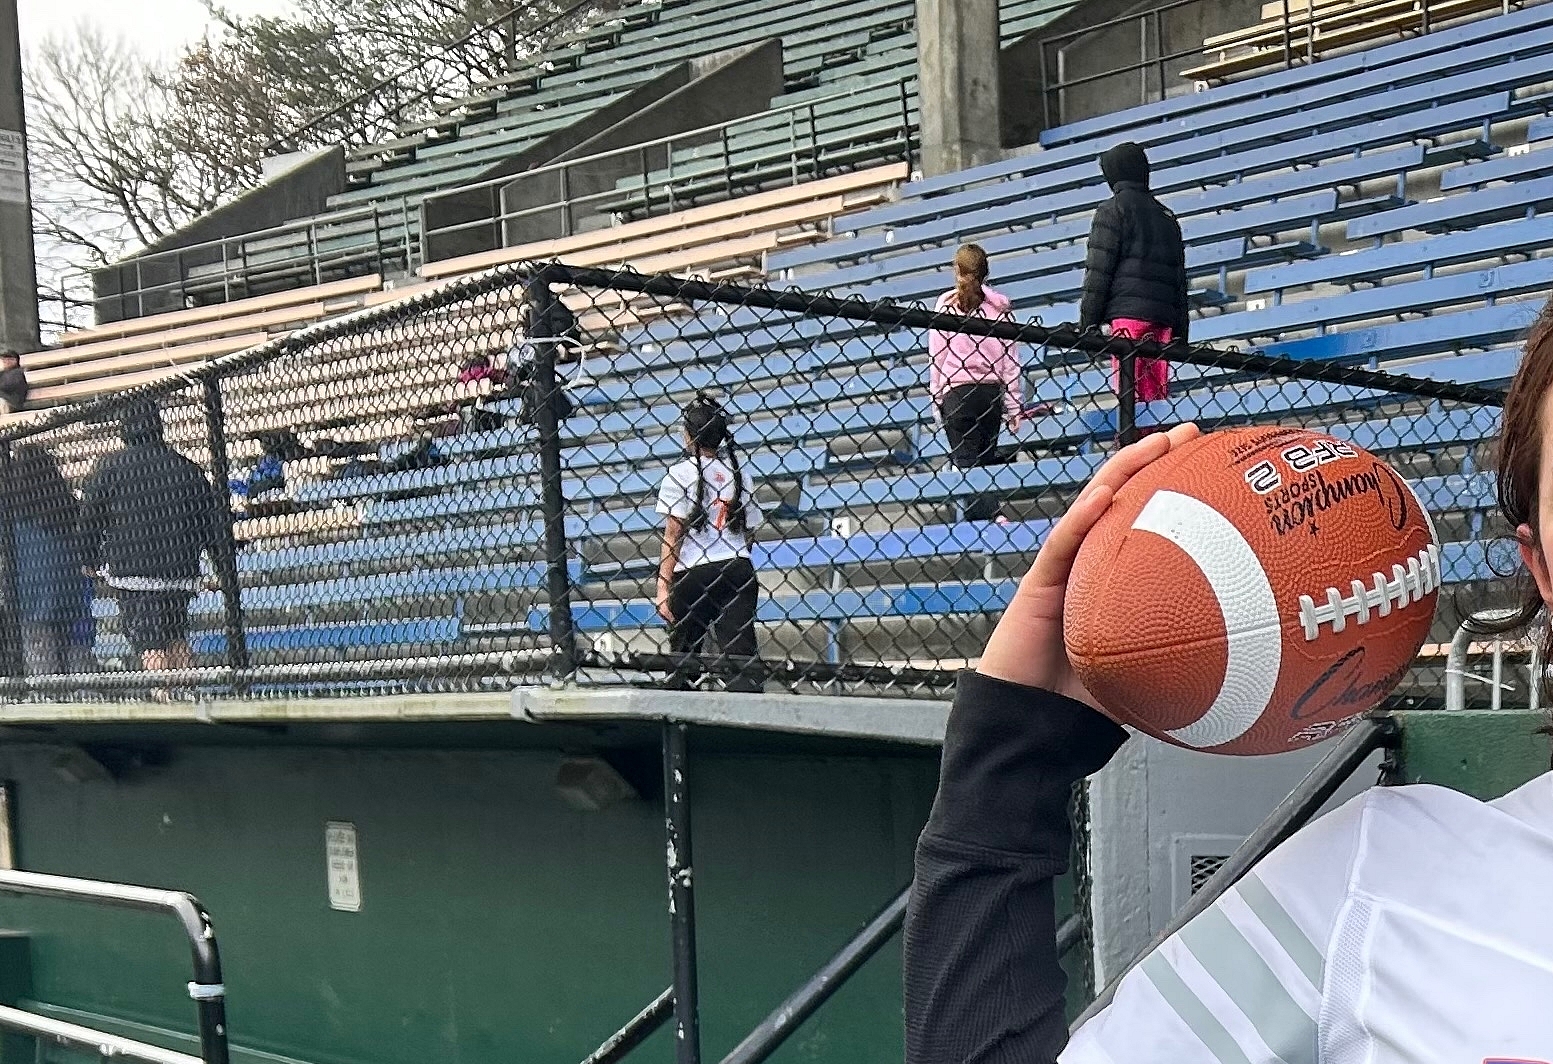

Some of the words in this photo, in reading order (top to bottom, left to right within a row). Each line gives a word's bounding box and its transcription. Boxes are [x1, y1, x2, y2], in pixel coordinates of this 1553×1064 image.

[1244, 460, 1282, 495] 2
[1264, 473, 1317, 515] SPORTS
[1270, 461, 1407, 536] Champion
